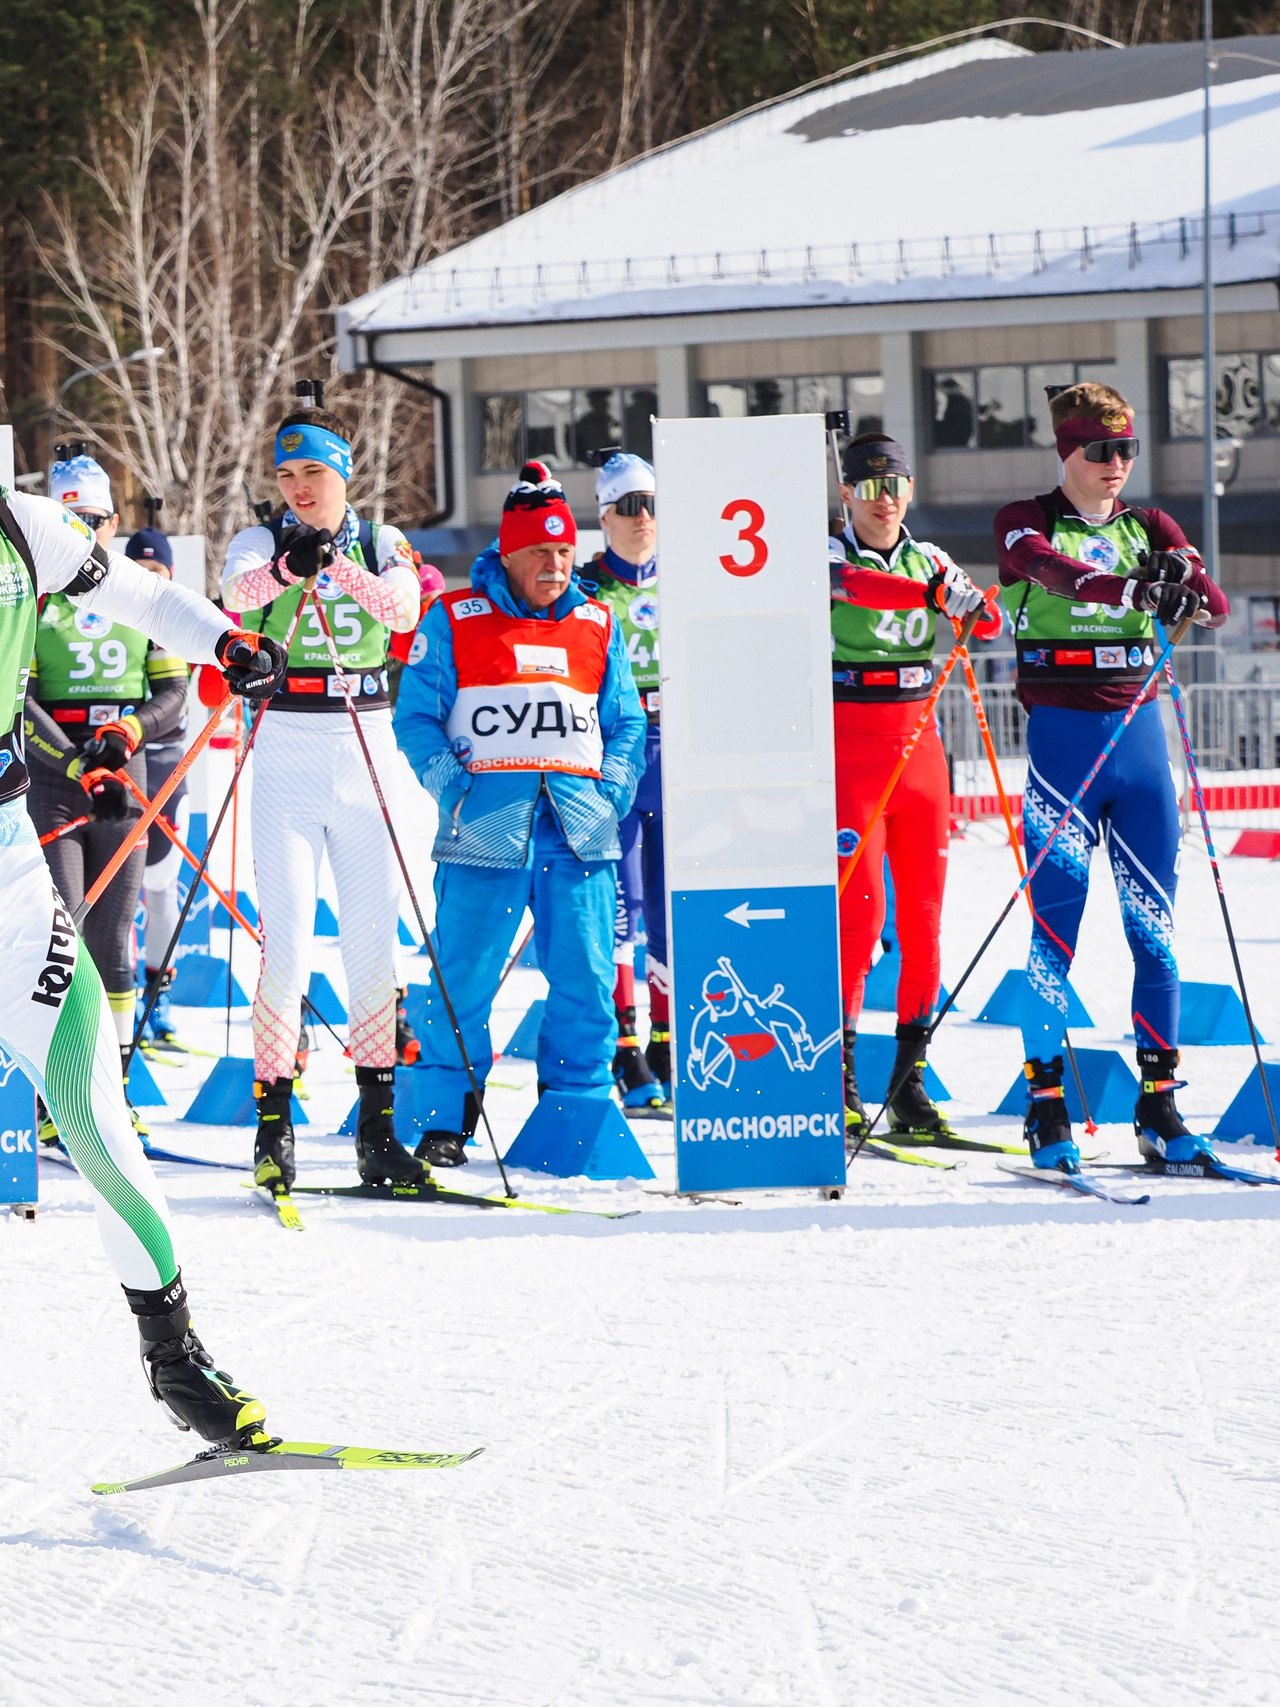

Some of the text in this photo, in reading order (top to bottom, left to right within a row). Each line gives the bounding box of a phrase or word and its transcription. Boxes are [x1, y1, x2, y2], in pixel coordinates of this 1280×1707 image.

[719, 499, 768, 577] 3
[461, 600, 483, 615] 35
[300, 603, 363, 647] 35
[874, 608, 930, 647] 40
[67, 639, 128, 680] 39
[471, 700, 597, 739] СУДЬЯ
[680, 1113, 841, 1142] КРАСНОЯРСК
[1164, 1163, 1205, 1177] SALOMON
[163, 1283, 183, 1306] 183
[223, 1455, 250, 1468] FISCHER
